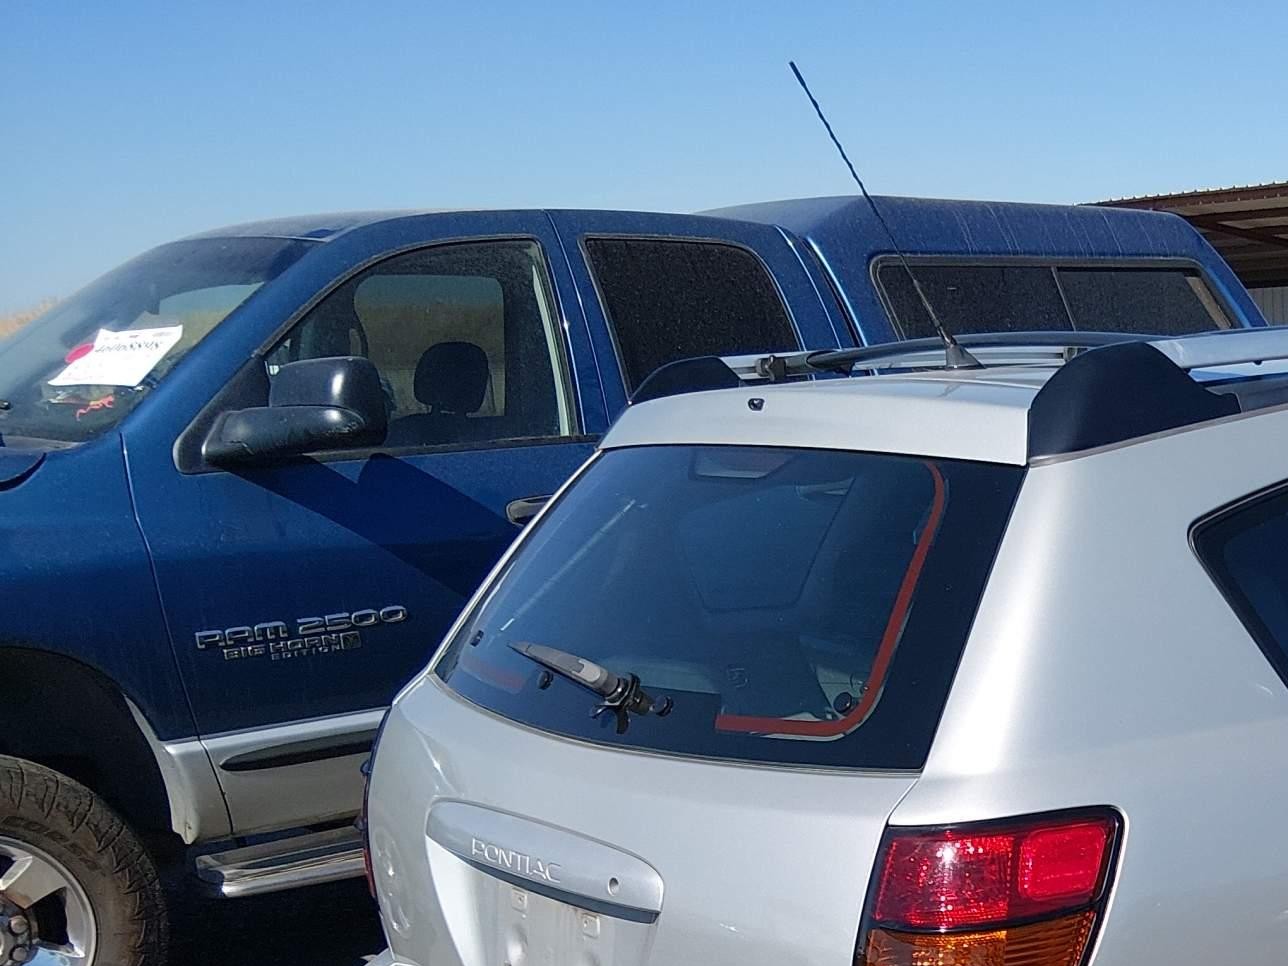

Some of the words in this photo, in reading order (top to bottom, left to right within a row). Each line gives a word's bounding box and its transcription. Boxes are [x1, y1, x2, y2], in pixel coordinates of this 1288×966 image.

[194, 620, 289, 649] RAM
[296, 604, 408, 636] 2500
[222, 645, 266, 661] BIG
[269, 632, 343, 653] HORN
[270, 644, 341, 662] EDITION
[471, 837, 562, 884] PONTIAC
